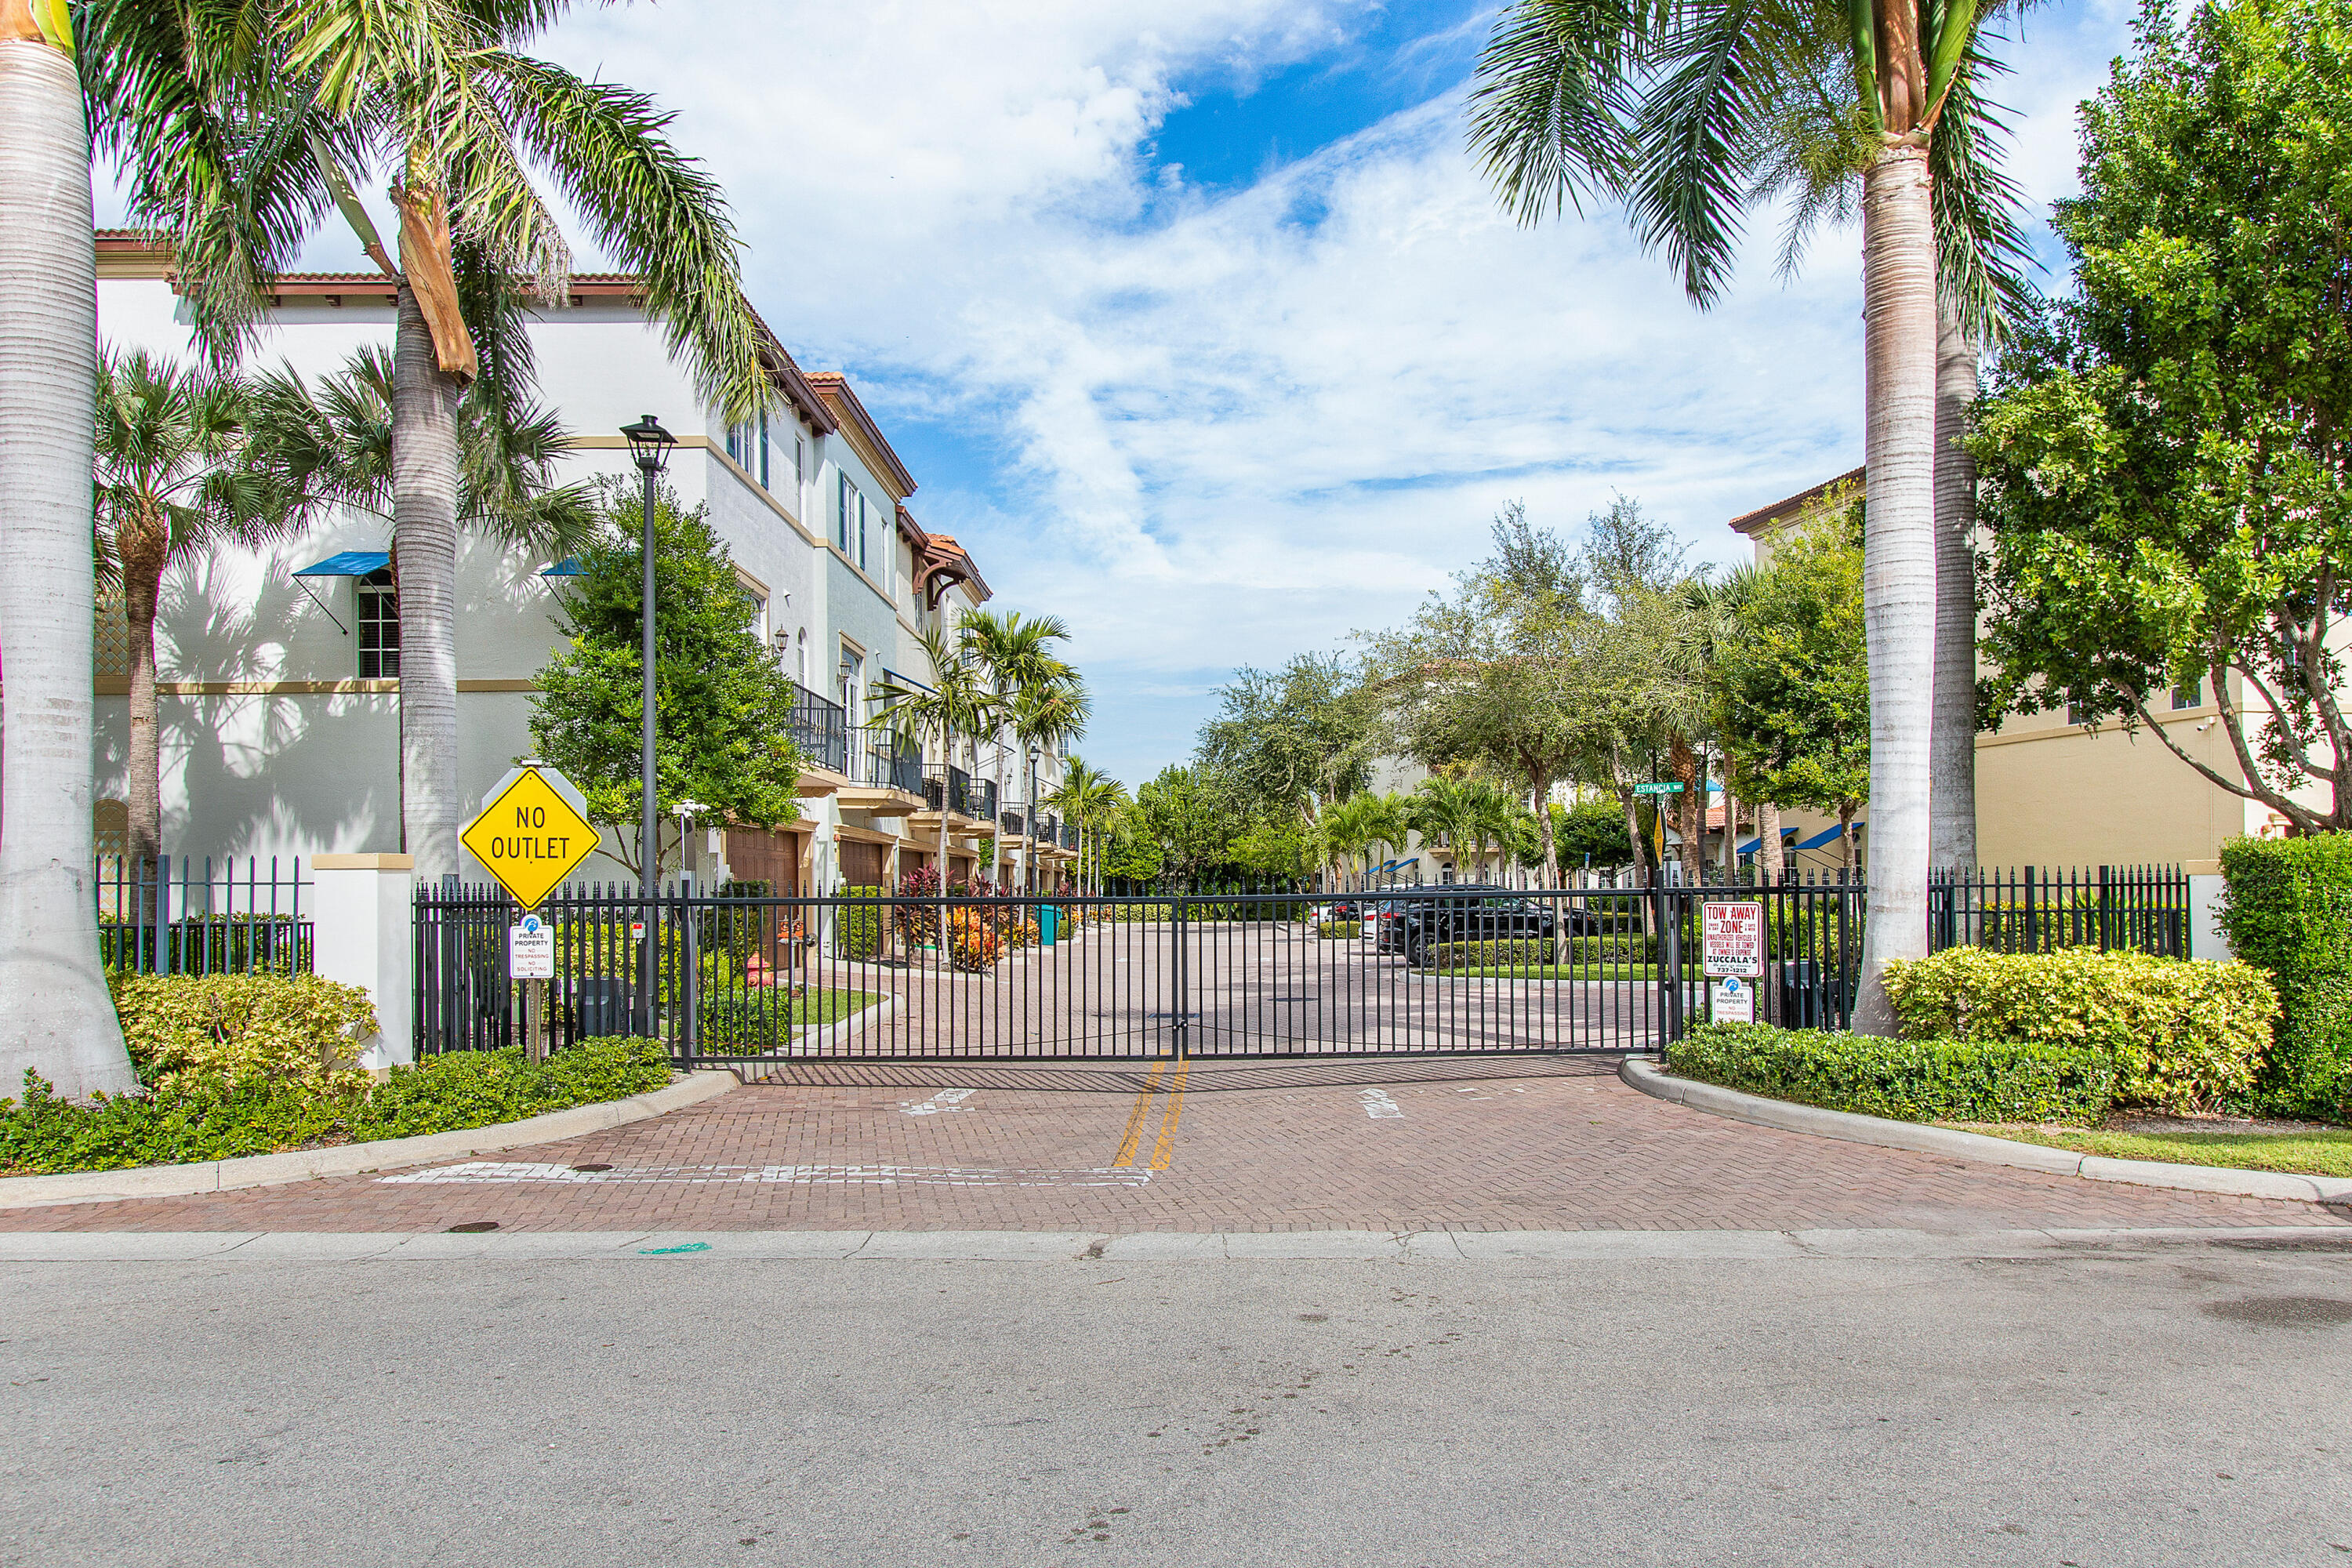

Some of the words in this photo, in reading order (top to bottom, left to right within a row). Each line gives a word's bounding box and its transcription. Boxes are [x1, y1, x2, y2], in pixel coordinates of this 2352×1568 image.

[1637, 784, 1670, 793] ESTANCIA
[517, 807, 545, 828] NO
[492, 837, 570, 859] OUTLET
[1708, 906, 1726, 920] TOW
[1730, 906, 1756, 920] AWAY
[1720, 920, 1743, 934] ZONE
